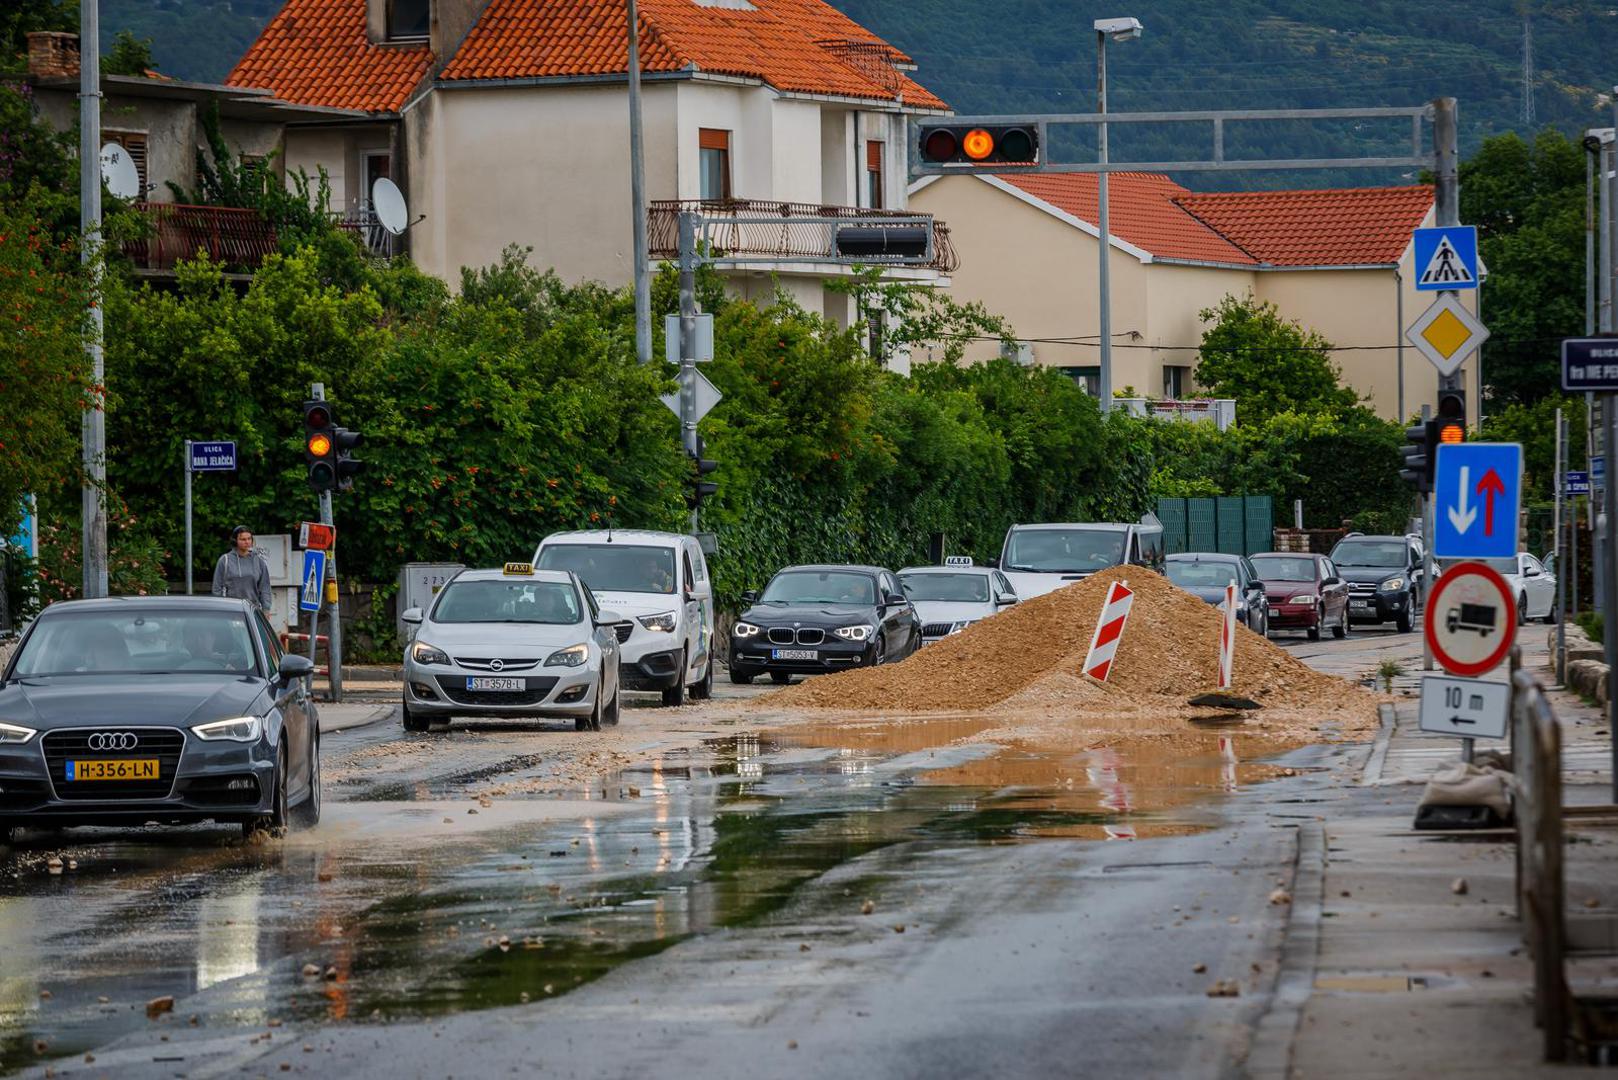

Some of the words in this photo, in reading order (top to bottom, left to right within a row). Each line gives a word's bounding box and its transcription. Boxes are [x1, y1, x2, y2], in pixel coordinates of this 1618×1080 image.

[1603, 365, 1618, 379] PE
[474, 679, 483, 688] ST
[1445, 686, 1462, 709] 10
[1469, 694, 1484, 711] m
[80, 762, 154, 777] H-356-LN
